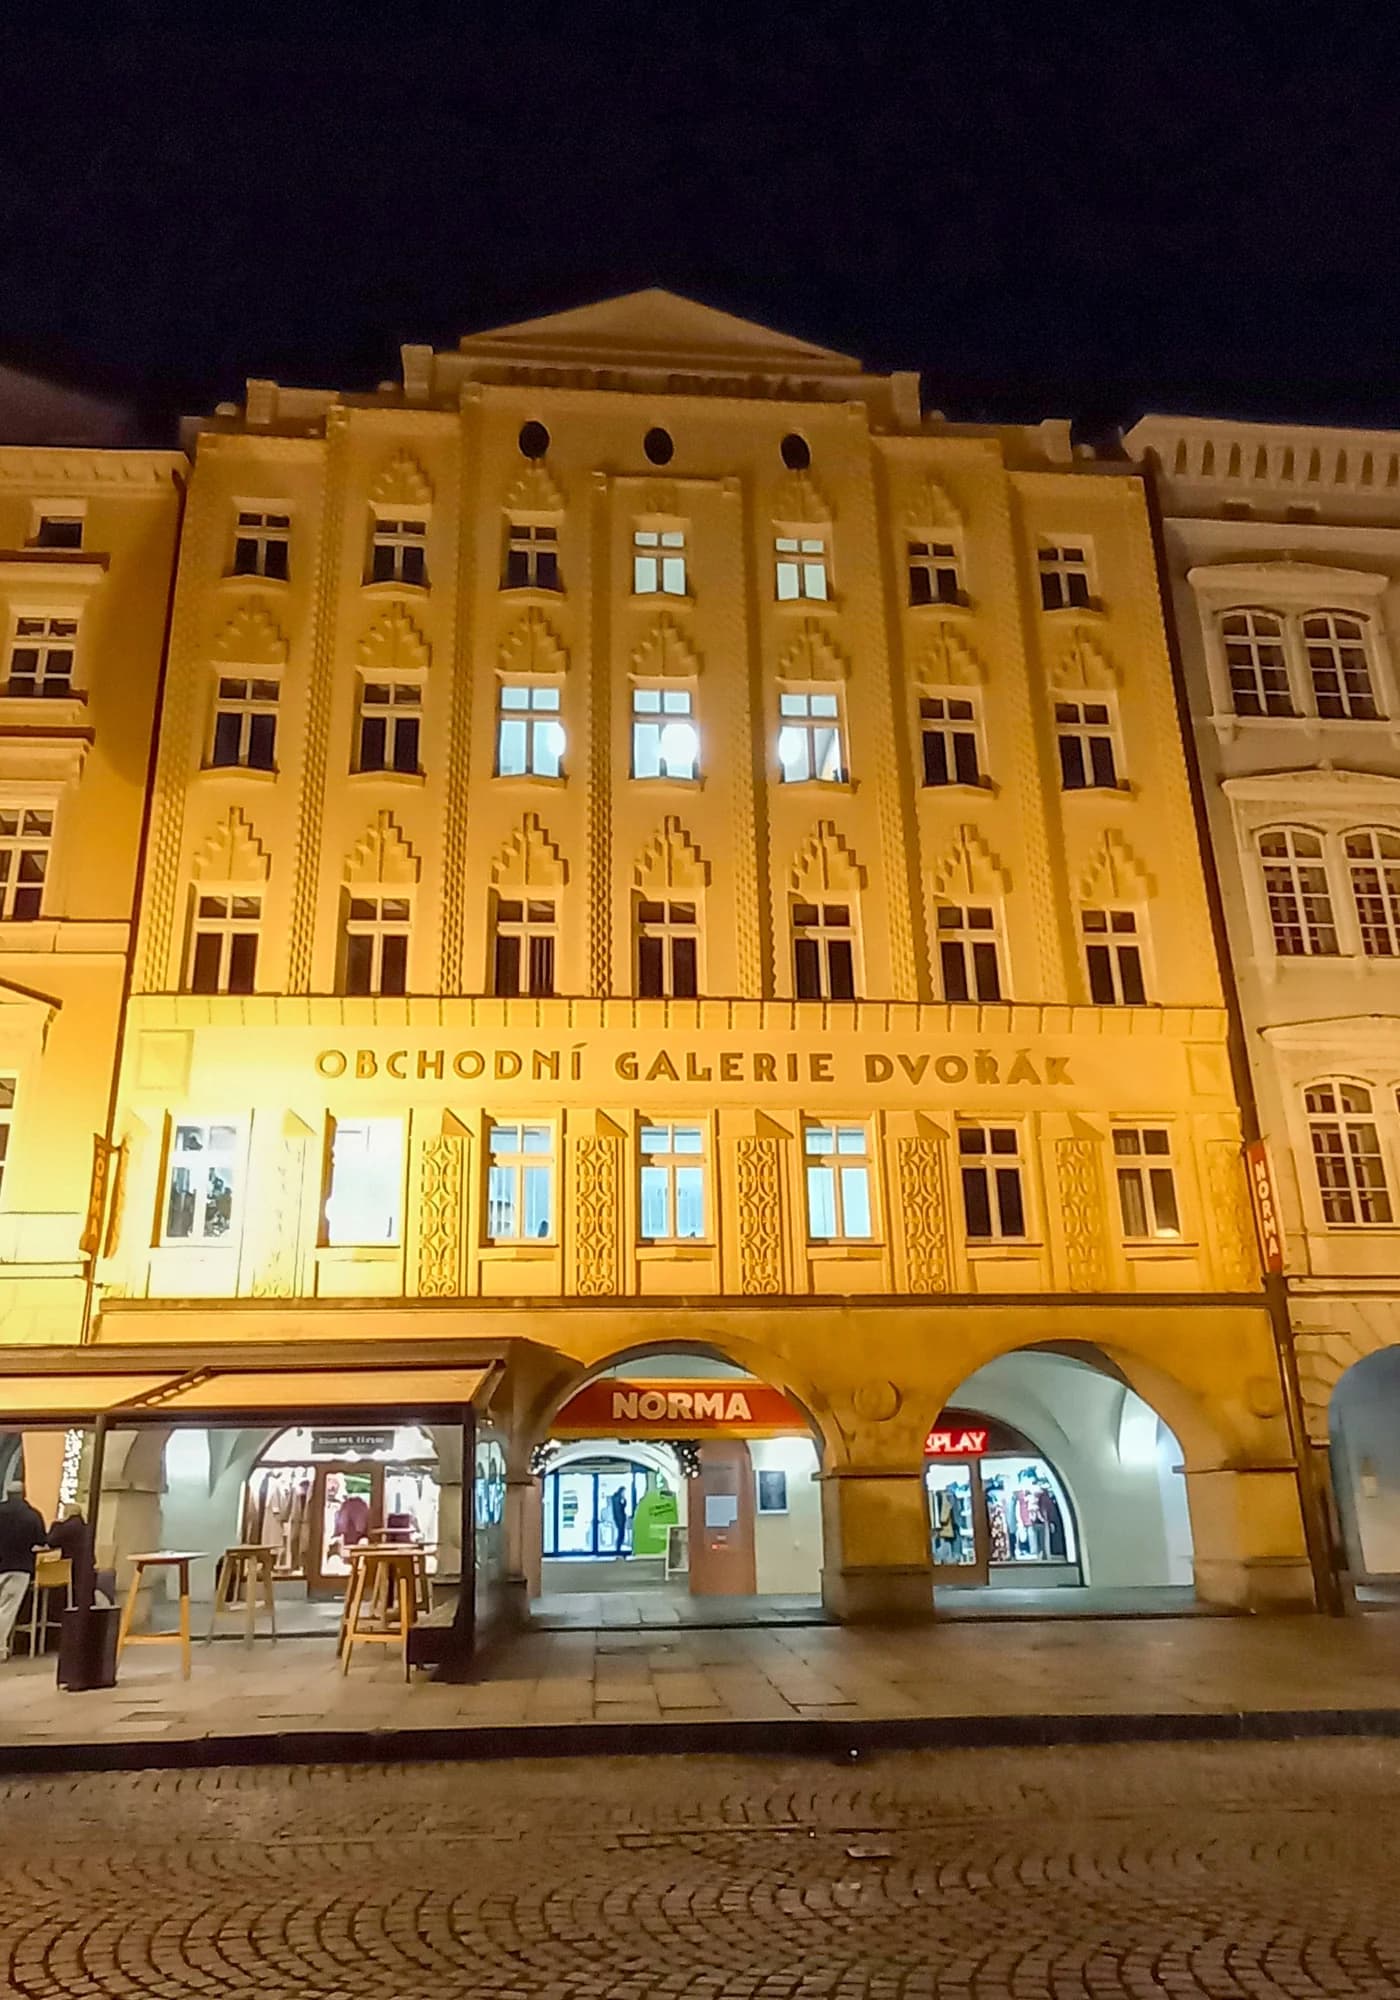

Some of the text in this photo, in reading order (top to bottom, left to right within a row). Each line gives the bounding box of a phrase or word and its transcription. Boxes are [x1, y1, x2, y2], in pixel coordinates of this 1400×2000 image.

[314, 1041, 1075, 1086] OBCHODNÍ GALERIE DVOŘÁK
[1255, 1160, 1279, 1257] NORMA
[612, 1391, 753, 1420] NORMA
